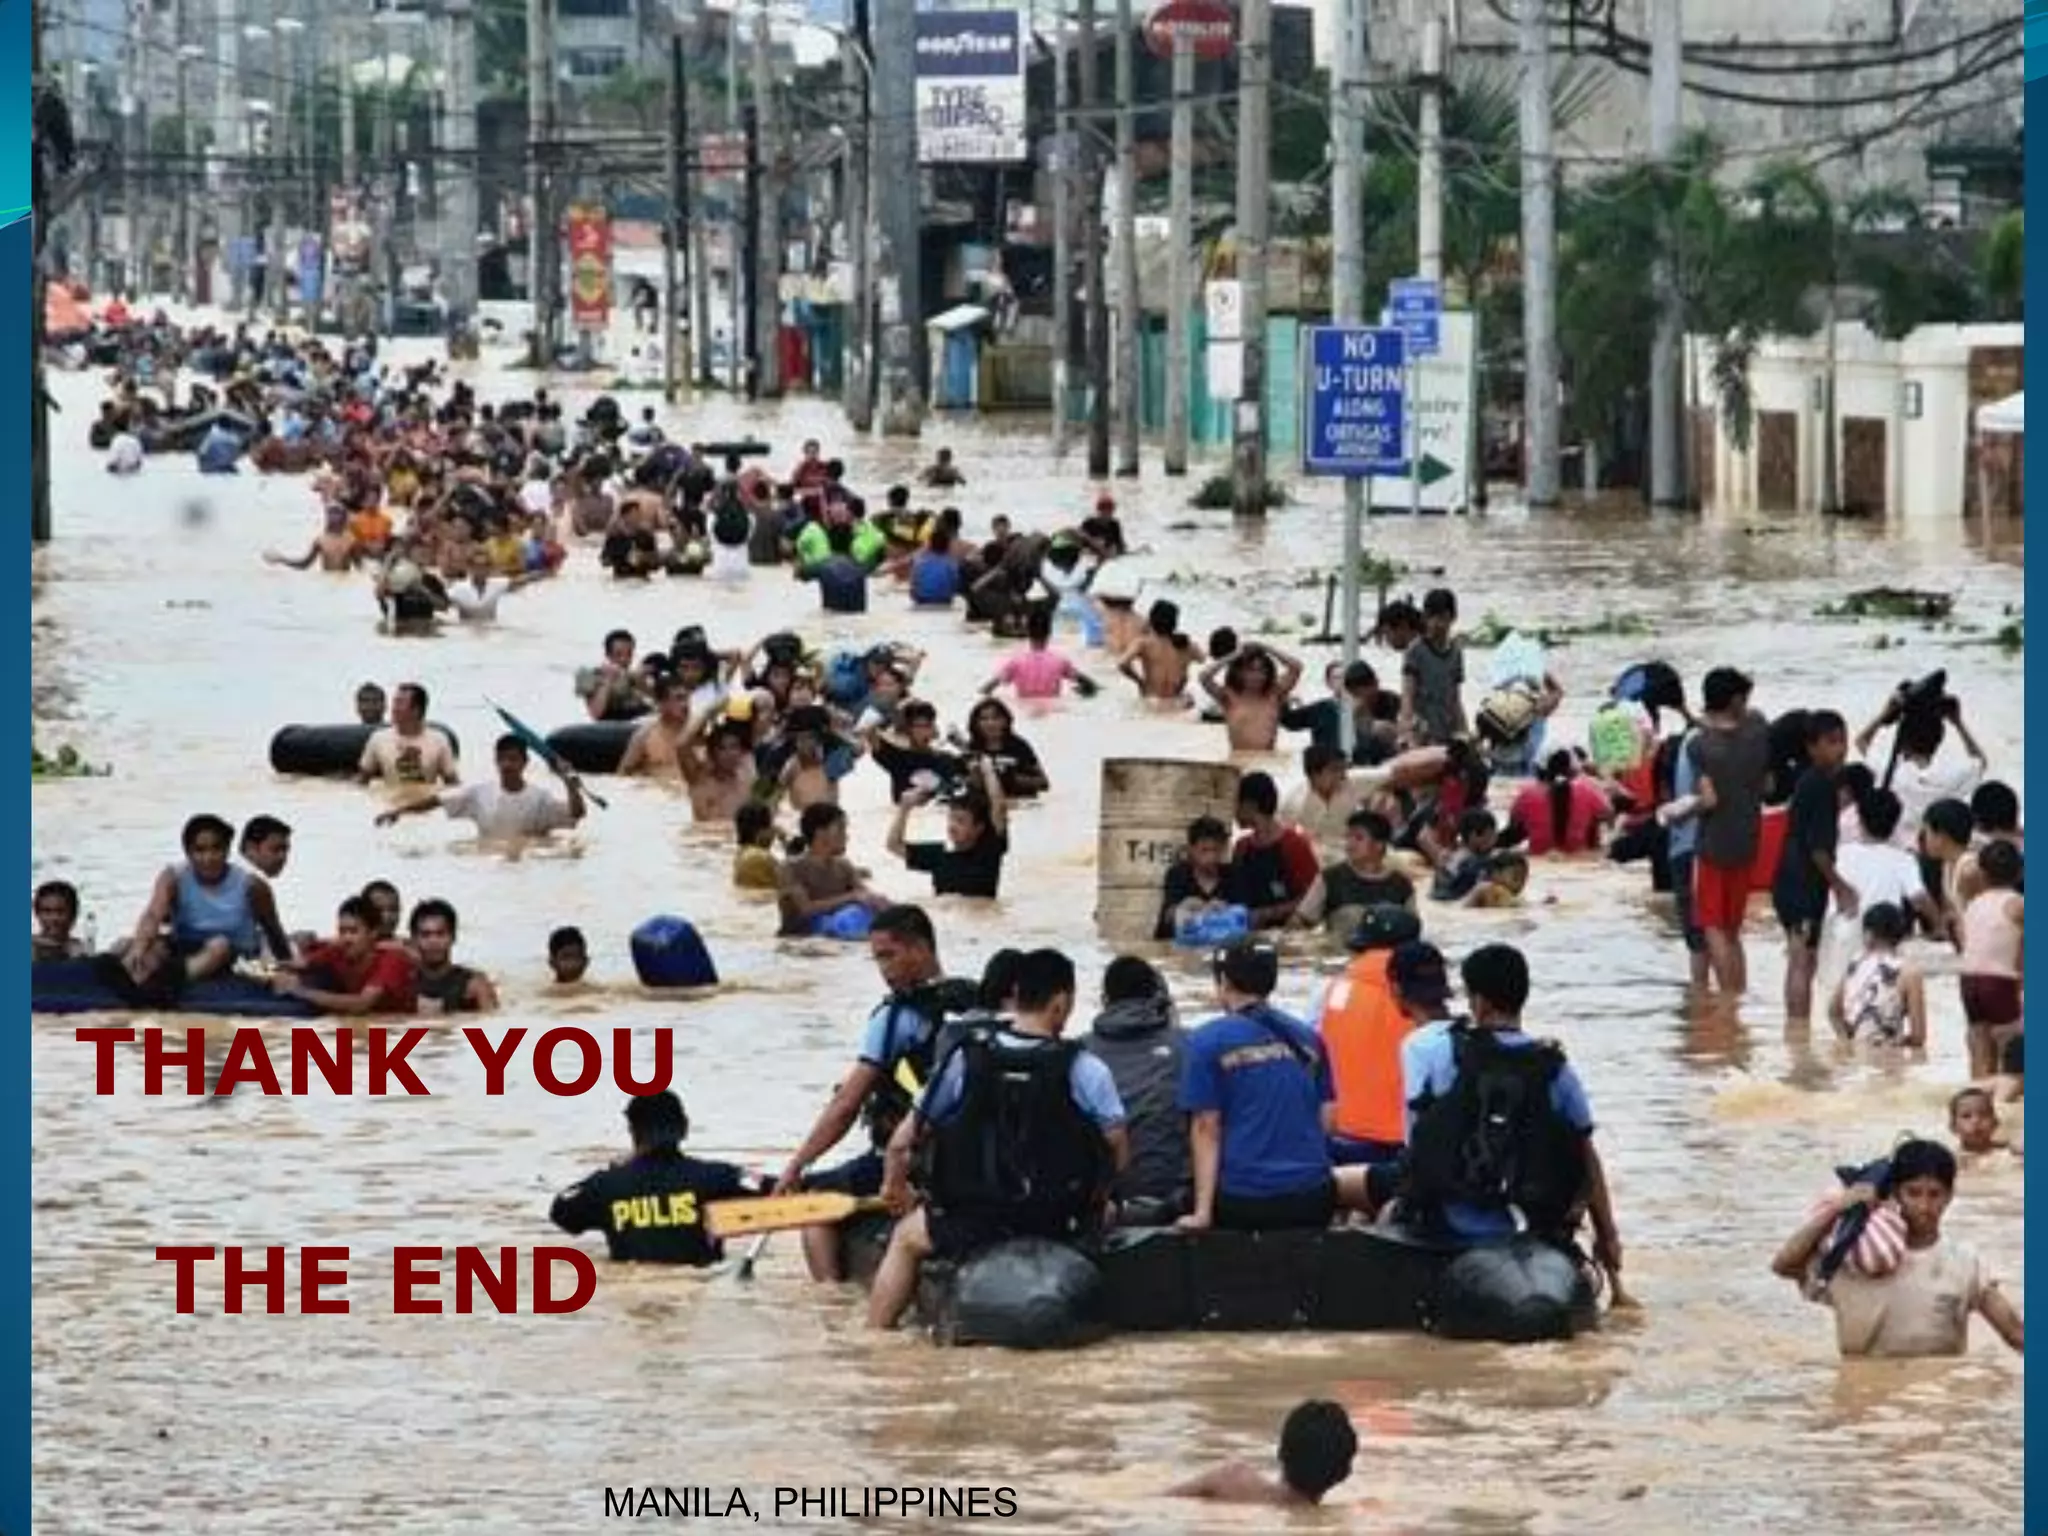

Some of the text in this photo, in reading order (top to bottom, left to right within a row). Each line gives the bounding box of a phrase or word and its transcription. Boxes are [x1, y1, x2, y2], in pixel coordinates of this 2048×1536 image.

[1344, 333, 1376, 359] NO
[1316, 365, 1402, 392] U-TURN
[612, 1192, 697, 1232] PULIS
